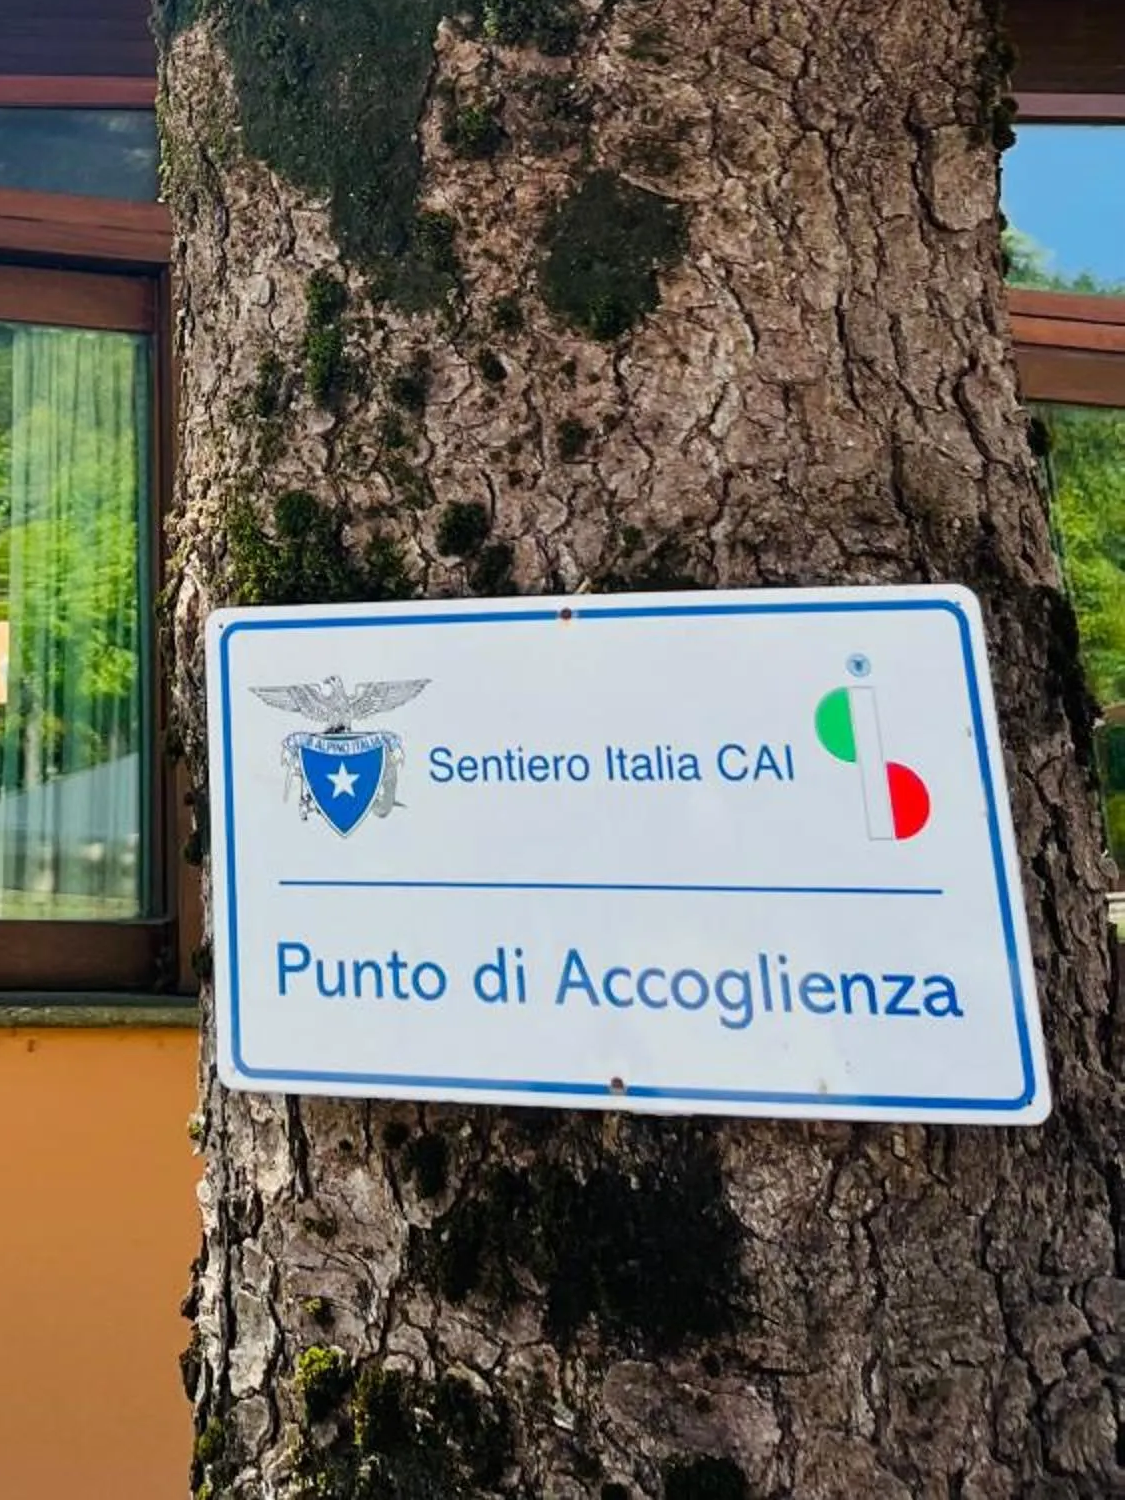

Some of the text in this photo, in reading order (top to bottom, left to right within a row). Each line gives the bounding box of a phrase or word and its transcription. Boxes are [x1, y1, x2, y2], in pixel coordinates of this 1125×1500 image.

[429, 743, 794, 783] Sentiero Italia CAI
[277, 941, 964, 1030] Punto di Accoglienza
